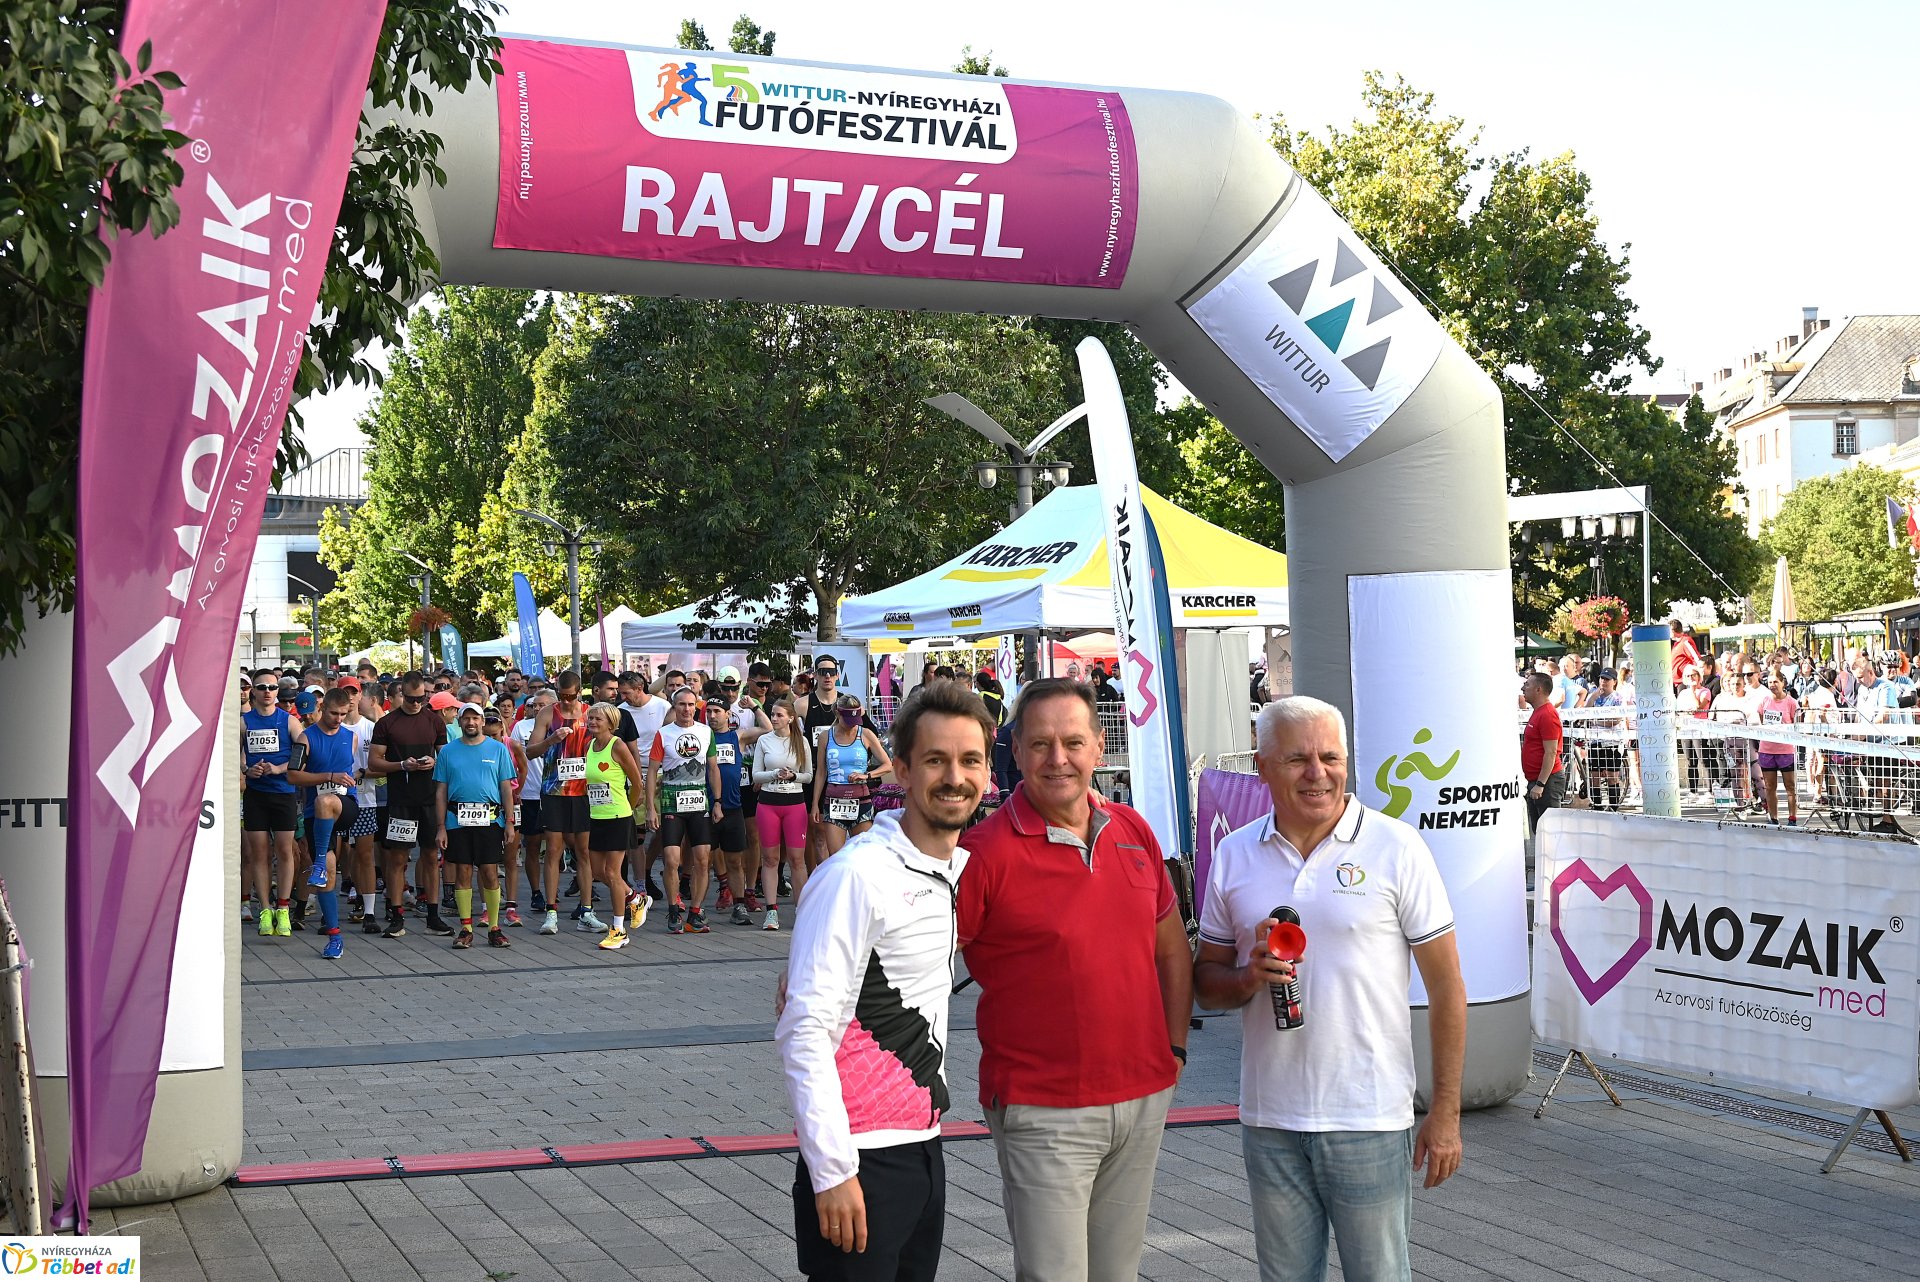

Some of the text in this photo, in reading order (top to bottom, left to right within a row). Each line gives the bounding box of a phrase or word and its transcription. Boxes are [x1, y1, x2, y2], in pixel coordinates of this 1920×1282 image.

[762, 82, 1001, 116] WITTUR-NYÍREGYHÁZI
[516, 71, 534, 200] www.mozaikmed.hu
[716, 101, 1007, 151] FUTÓFESZTIVÁL
[1097, 97, 1122, 278] www.nyiregyhazifutofesztival.hu
[621, 165, 1025, 260] RAJT/CÉL
[276, 195, 313, 314] med
[1264, 324, 1331, 394] WITTUR
[197, 579, 217, 611] Az
[215, 498, 245, 574] orvosi
[961, 541, 1079, 568] KÄRCHER
[1181, 595, 1257, 609] KÄRCHER
[708, 628, 759, 643] KÄRC
[249, 736, 277, 746] 21053
[716, 749, 734, 757] 1108
[560, 764, 585, 774] 21106
[589, 790, 609, 799] 21124
[679, 796, 704, 805] 21300
[1438, 775, 1520, 806] SPORTOLÓ
[460, 810, 487, 819] 21091
[832, 804, 857, 814] 21115
[1418, 808, 1501, 830] NEMZET
[389, 825, 416, 835] 21067
[1654, 988, 1813, 1032] Az orvosi futóközösség
[1818, 984, 1887, 1019] med
